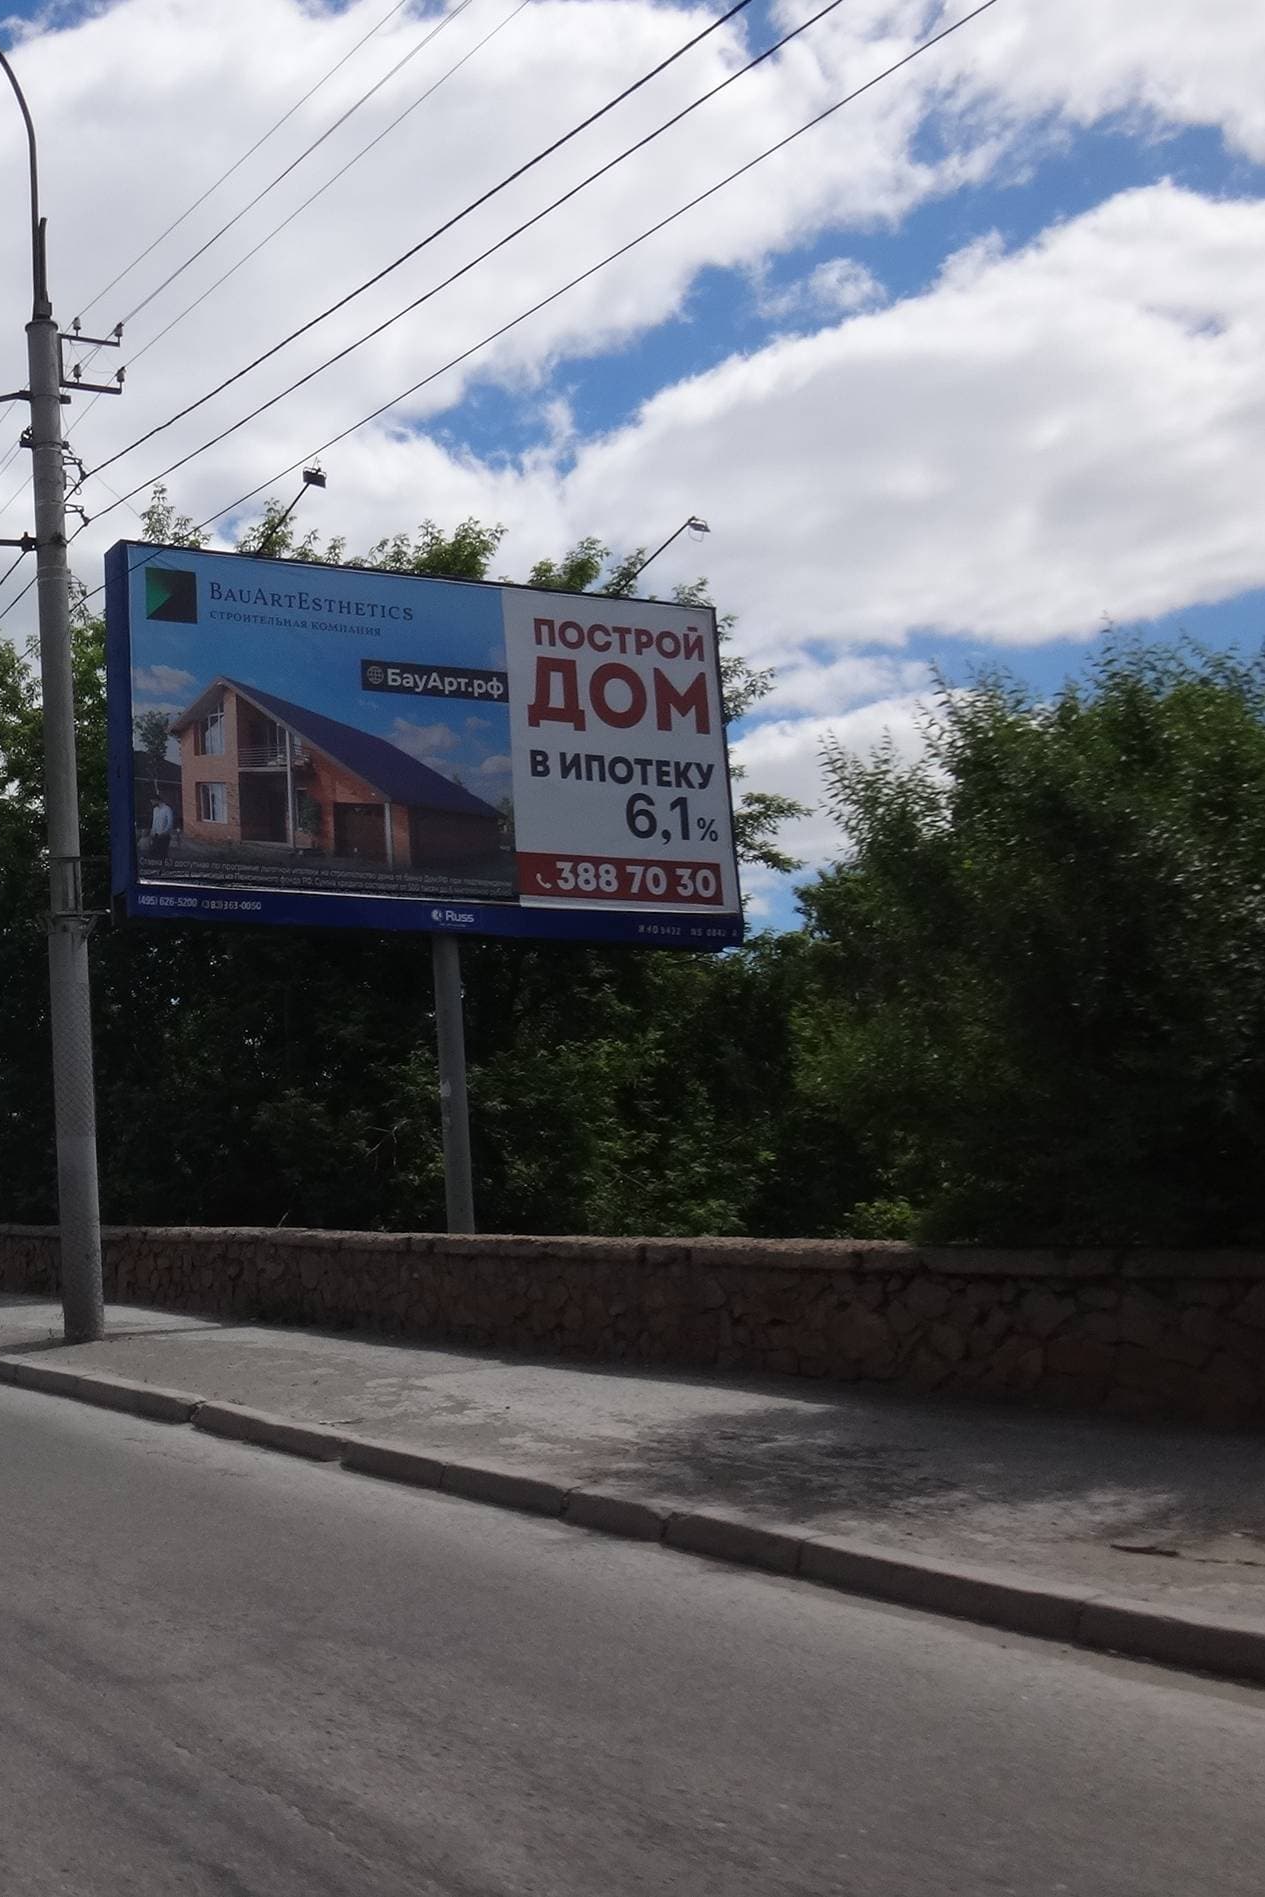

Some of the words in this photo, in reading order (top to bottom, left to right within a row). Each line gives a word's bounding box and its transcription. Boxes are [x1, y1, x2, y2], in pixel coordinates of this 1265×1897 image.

[533, 617, 705, 662] ПОСТРОЙ
[386, 668, 504, 699] БауАрт.рф
[527, 656, 711, 735] ДОМ
[529, 749, 551, 778] В
[559, 752, 715, 790] ИПОТЕКУ
[555, 861, 619, 893] 388
[626, 865, 668, 896] 70
[675, 868, 717, 898] 30
[445, 910, 475, 923] Russ
